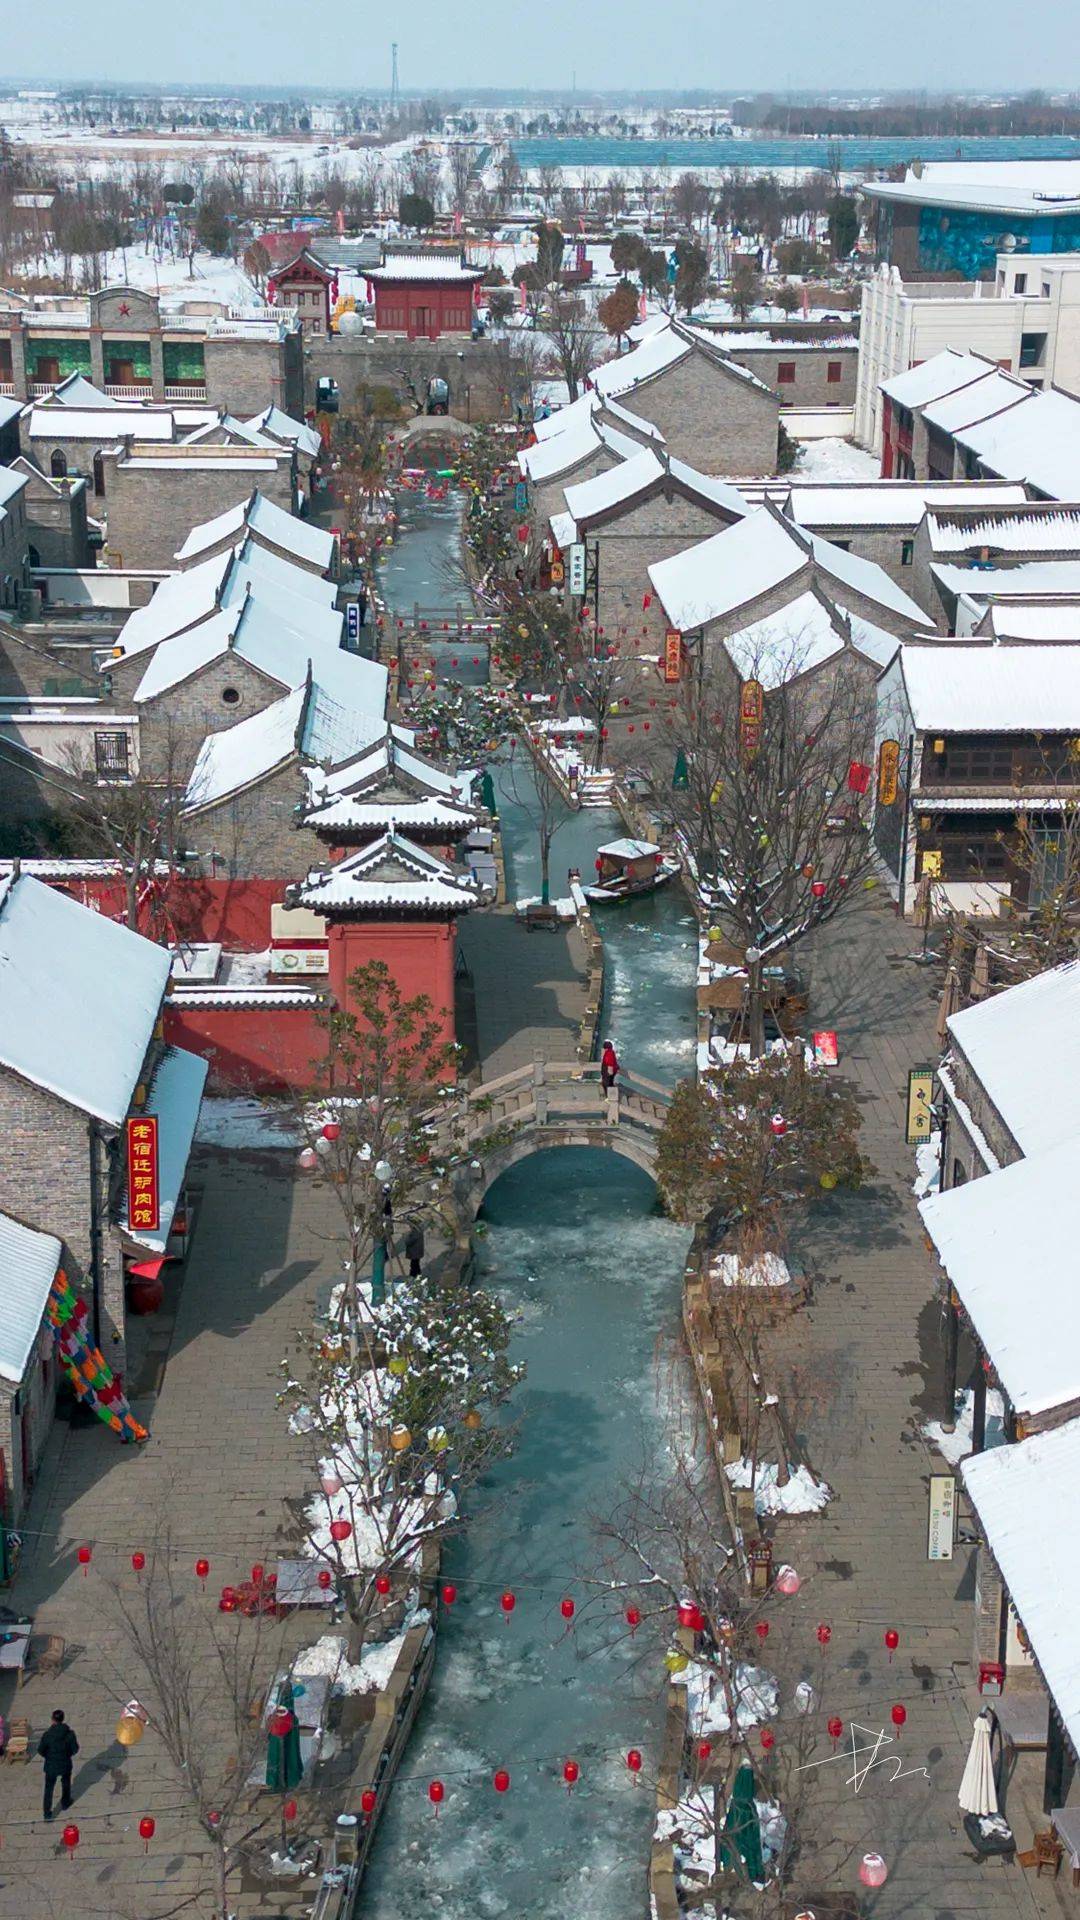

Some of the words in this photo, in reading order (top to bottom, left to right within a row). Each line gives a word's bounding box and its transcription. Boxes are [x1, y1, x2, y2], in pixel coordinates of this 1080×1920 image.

[132, 1125, 152, 1223] 老宿迁驴肉馆
